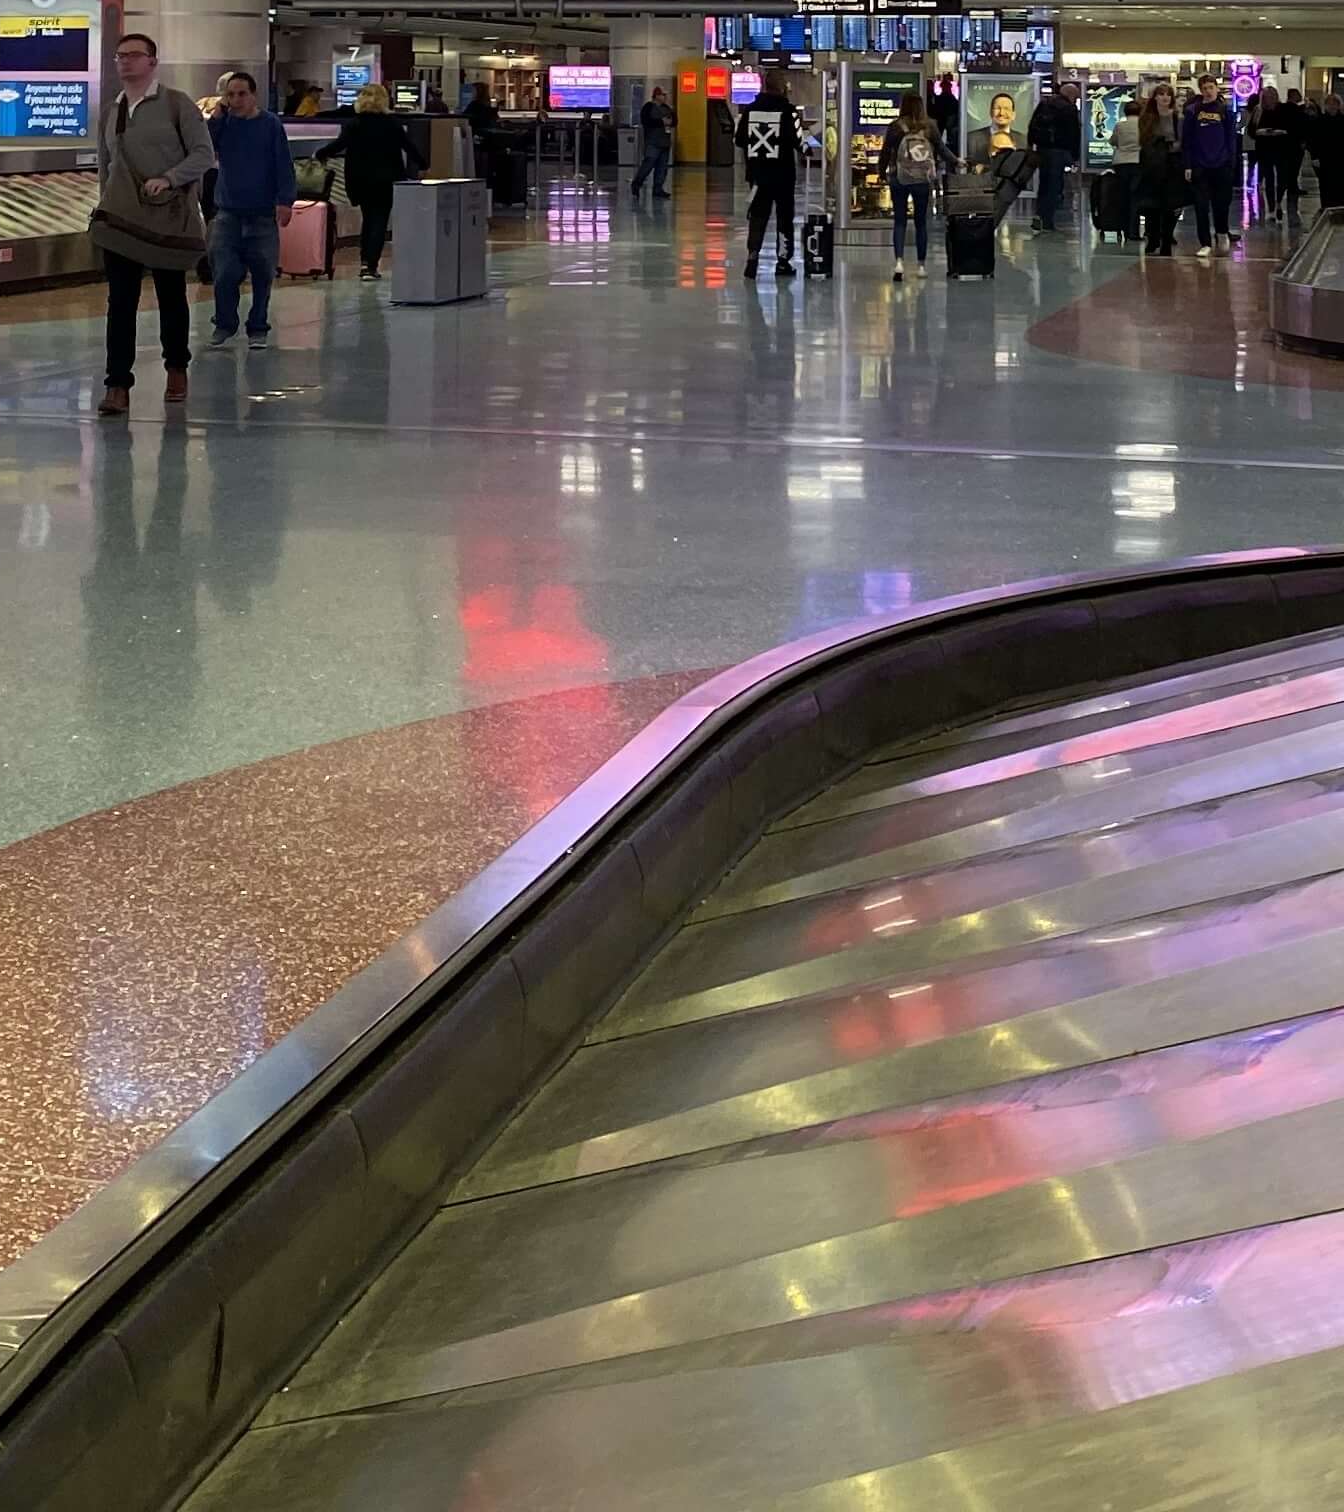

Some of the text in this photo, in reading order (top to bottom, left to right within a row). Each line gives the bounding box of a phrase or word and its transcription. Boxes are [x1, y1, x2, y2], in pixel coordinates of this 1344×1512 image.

[29, 17, 61, 27] spirit
[348, 46, 360, 62] 7
[1069, 68, 1078, 80] 3
[24, 84, 83, 95] Anyone who asks
[30, 96, 44, 106] you
[45, 94, 62, 104] need
[68, 94, 82, 104] ride
[64, 105, 74, 115] be
[49, 118, 63, 128] you
